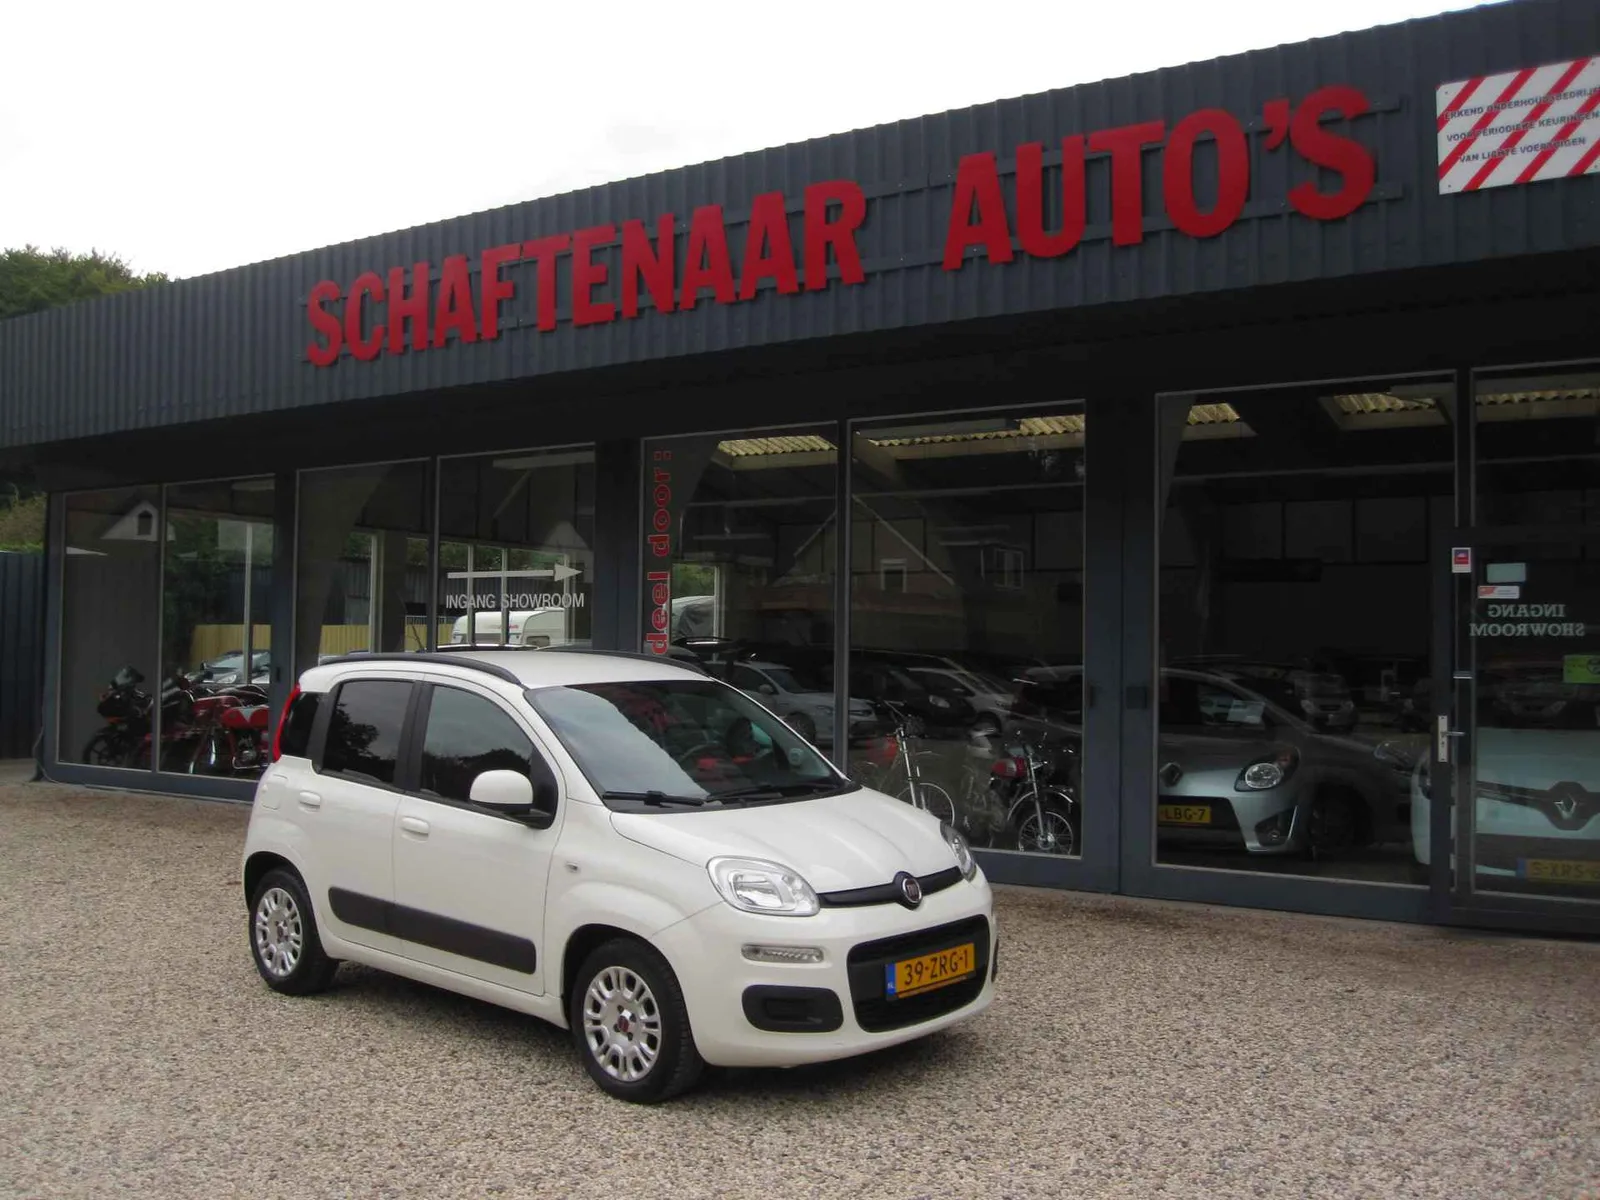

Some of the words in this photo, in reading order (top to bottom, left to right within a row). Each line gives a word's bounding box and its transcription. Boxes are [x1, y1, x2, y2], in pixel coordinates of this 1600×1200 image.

[1444, 106, 1484, 121] ERKEND
[1460, 152, 1480, 164] VAN
[306, 179, 866, 367] SCHAFTENAAR
[942, 84, 1375, 271] AUTO'S
[446, 594, 496, 609] INGANG
[500, 592, 585, 609] SHOWROOM
[904, 948, 969, 985] 39-ZRG-1
